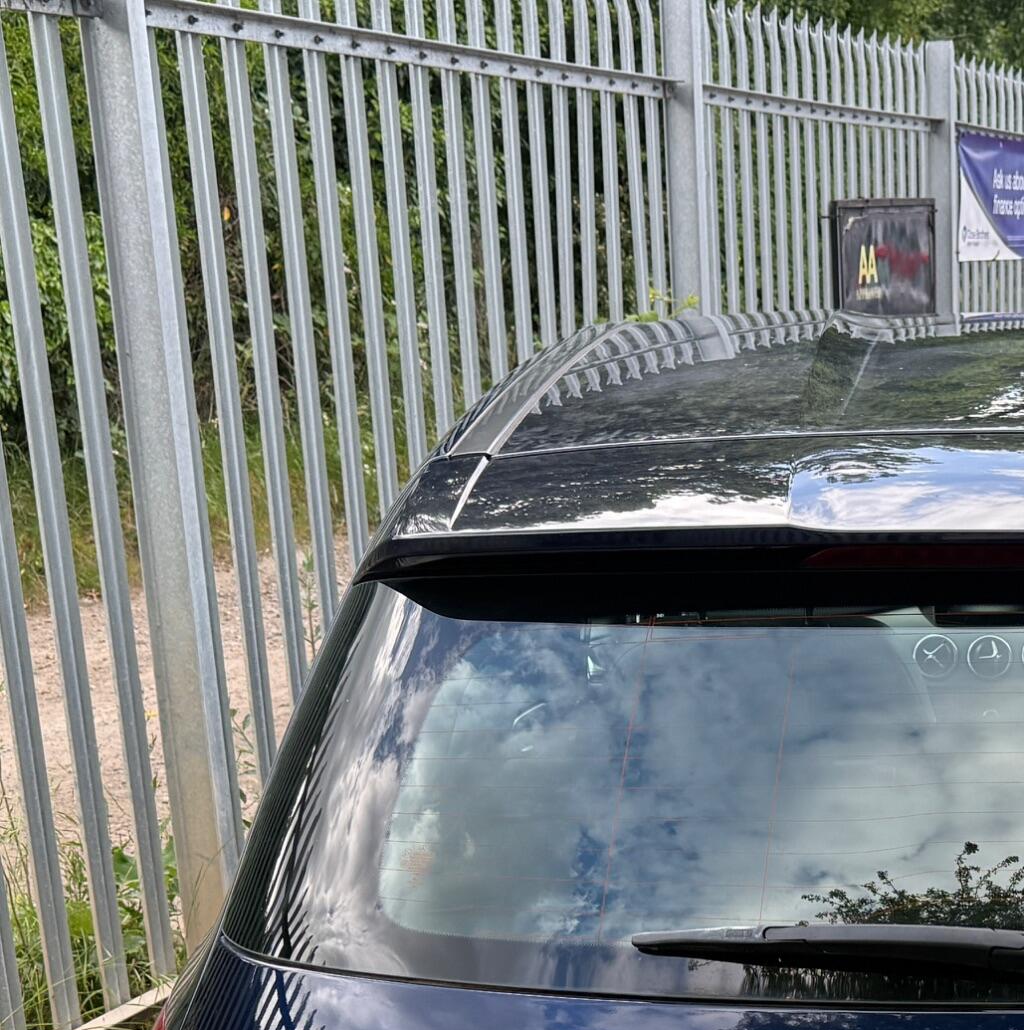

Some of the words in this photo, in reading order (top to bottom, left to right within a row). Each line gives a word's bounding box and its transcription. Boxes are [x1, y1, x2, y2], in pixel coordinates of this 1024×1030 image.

[993, 168, 1003, 189] Ask
[1005, 174, 1012, 190] us
[993, 194, 1013, 215] finance
[858, 244, 879, 284] AA
